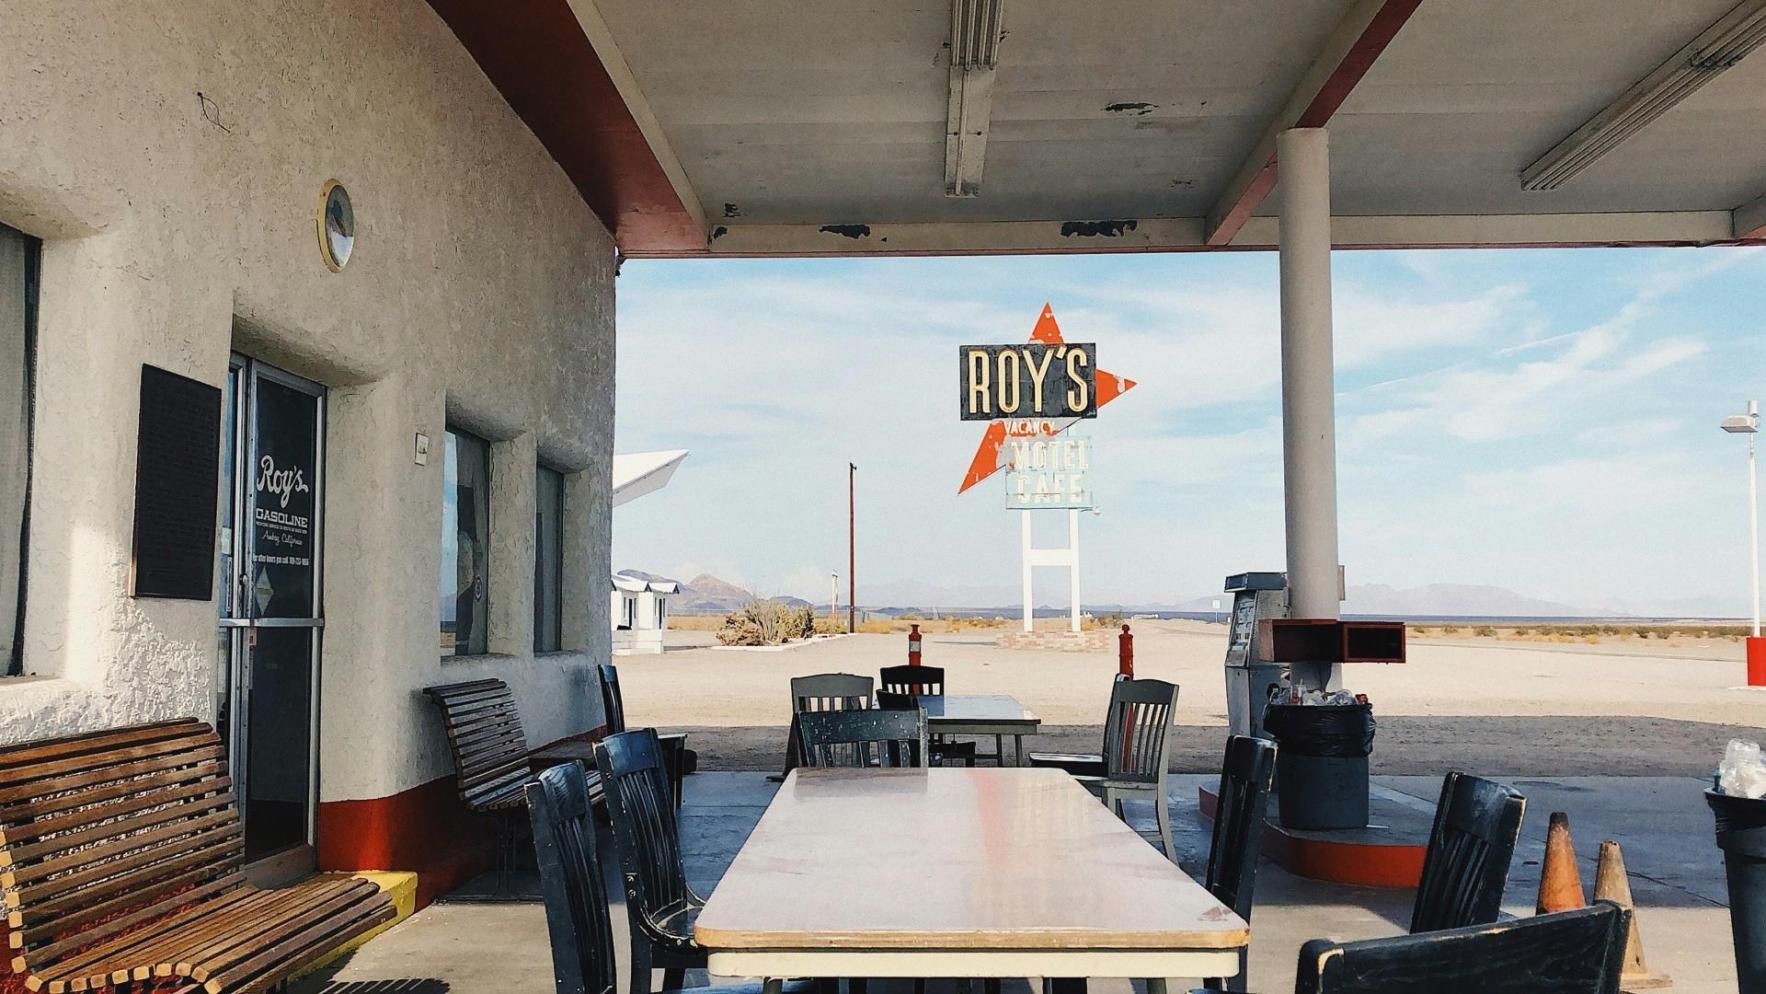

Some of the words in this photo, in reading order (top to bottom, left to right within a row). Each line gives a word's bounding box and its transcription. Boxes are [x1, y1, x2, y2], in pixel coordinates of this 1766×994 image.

[968, 345, 1088, 414] ROY'S
[1004, 420, 1056, 434] VACANCY
[1011, 440, 1089, 470] MOTEL
[256, 454, 309, 509] Roy's
[1017, 474, 1082, 503] CAFE
[255, 507, 308, 528] GASOLINE
